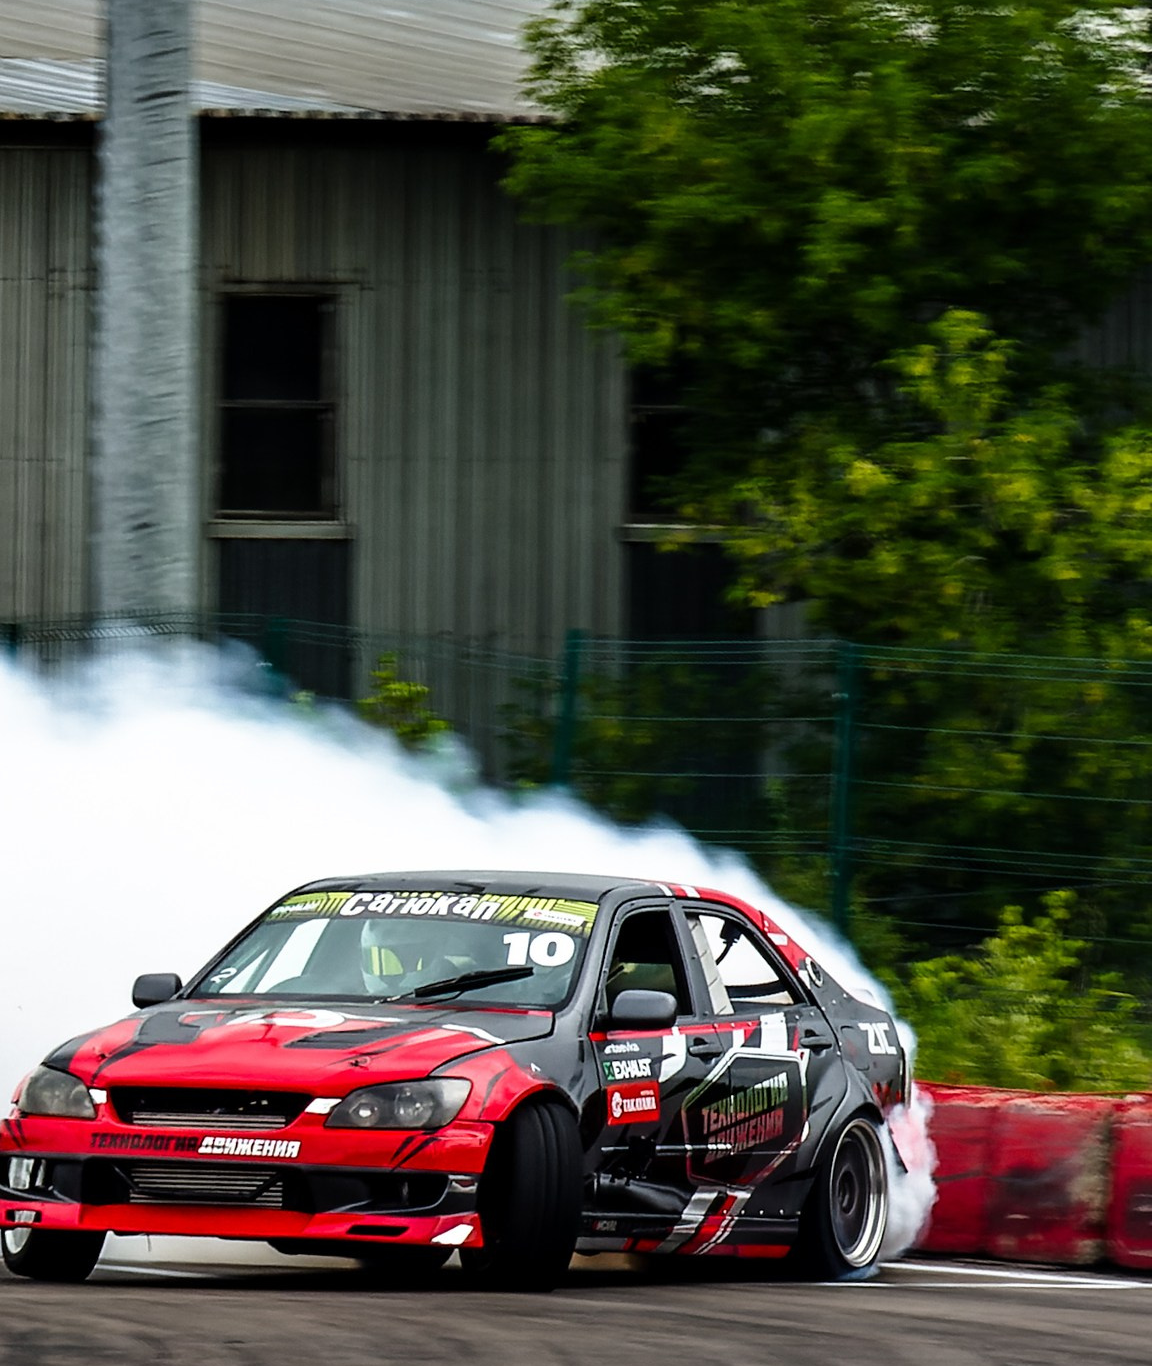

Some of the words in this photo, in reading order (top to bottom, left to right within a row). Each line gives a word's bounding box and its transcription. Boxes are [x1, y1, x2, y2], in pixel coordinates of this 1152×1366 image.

[503, 932, 575, 967] 10
[858, 1022, 898, 1055] ZIC
[612, 1058, 652, 1080] EXHAUST
[90, 1133, 198, 1152] ТЕХНОЛОГИЯ
[198, 1136, 301, 1159] ДВИЖЕНИЯ
